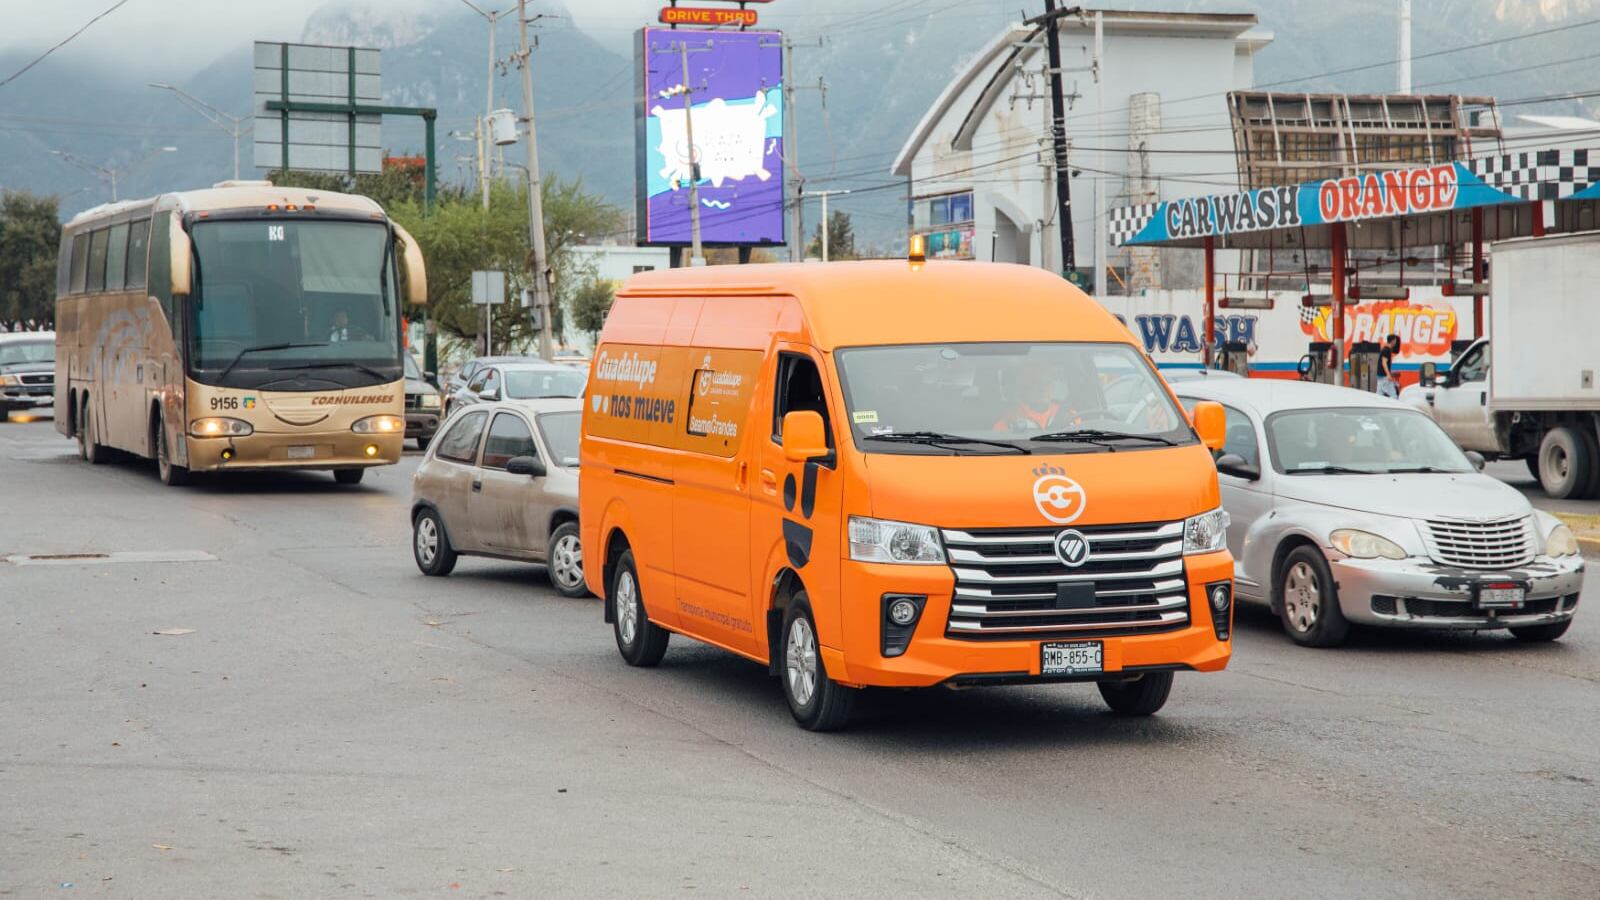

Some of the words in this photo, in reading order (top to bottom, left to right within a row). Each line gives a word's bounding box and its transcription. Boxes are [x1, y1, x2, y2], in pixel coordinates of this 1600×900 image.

[667, 10, 711, 22] DRIVE
[715, 12, 756, 23] THRU
[1319, 162, 1458, 223] ORANGE
[596, 350, 657, 391] Guadalupe
[210, 396, 239, 410] 9156
[311, 394, 394, 406] COAHUILENSES
[610, 394, 632, 418] nos
[633, 396, 676, 424] mueve
[1043, 650, 1102, 665] RMB-855-C
